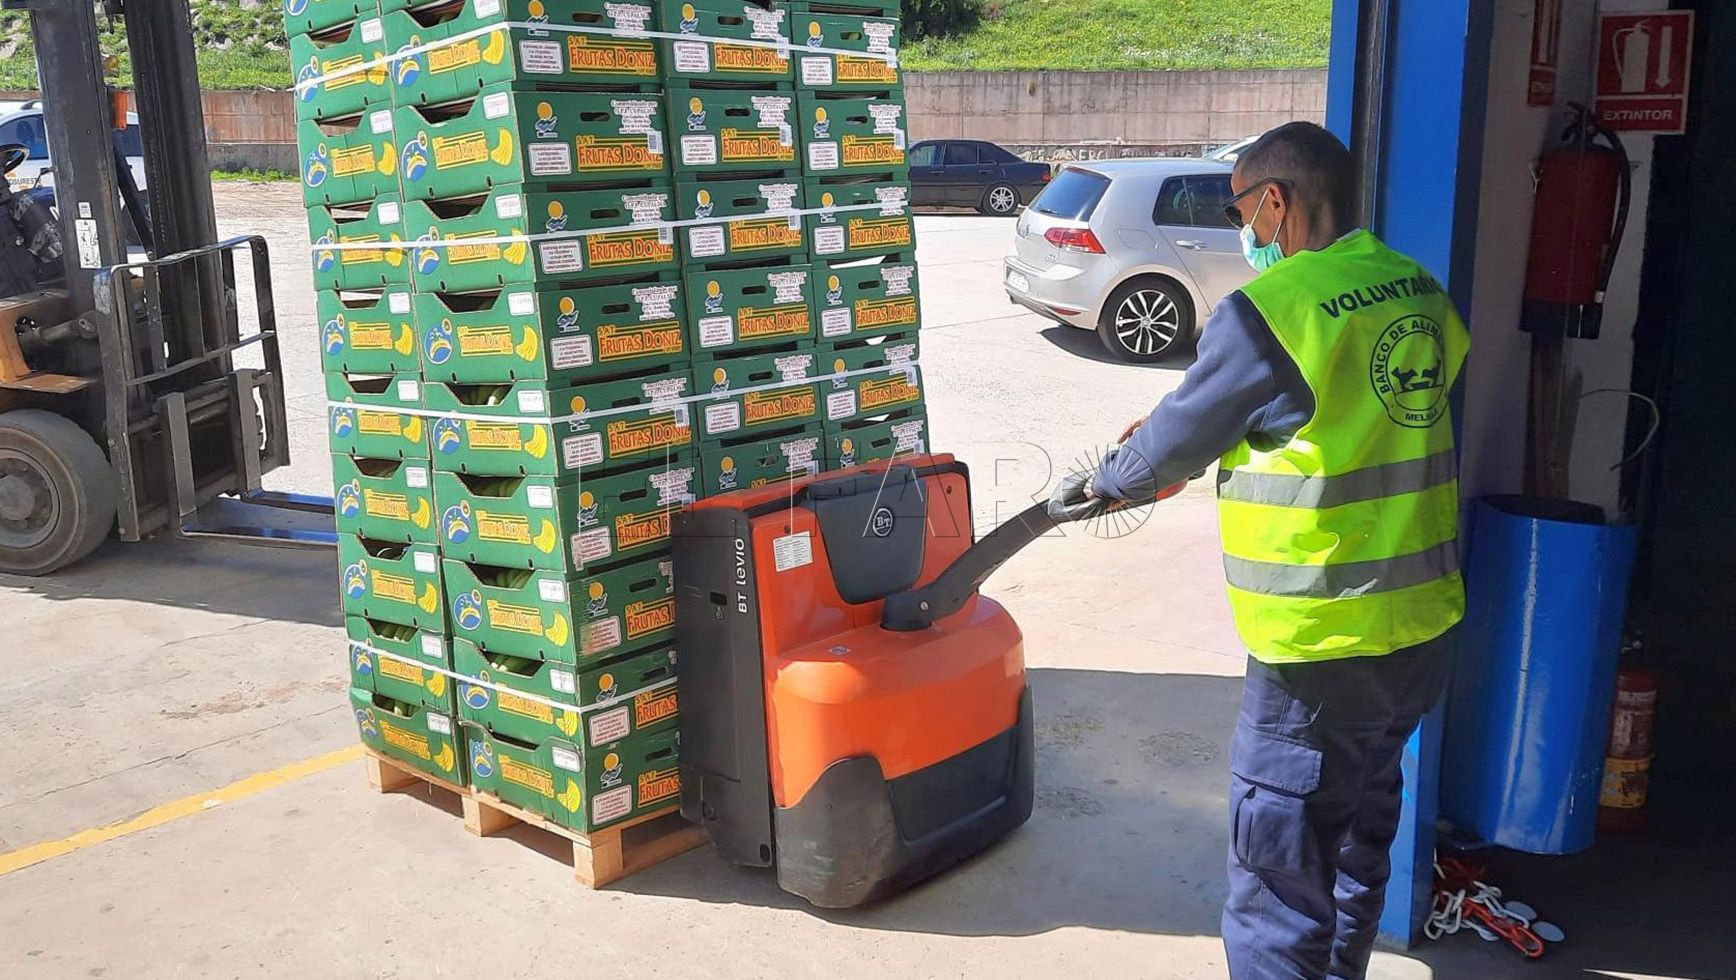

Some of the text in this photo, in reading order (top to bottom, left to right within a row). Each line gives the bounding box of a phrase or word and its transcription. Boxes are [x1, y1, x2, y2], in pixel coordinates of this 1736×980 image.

[571, 47, 614, 67] FRUTAS
[616, 48, 655, 68] DONIZ
[716, 50, 751, 67] FRUTAS
[839, 62, 868, 77] FRUTAS
[1603, 109, 1673, 121] EXTINTOR
[580, 146, 624, 165] FRUTAS
[723, 139, 761, 156] FRUTAS
[845, 145, 876, 161] FRUTAS
[731, 228, 768, 244] FRUTAS
[850, 229, 881, 244] FRUTAS
[881, 225, 909, 241] DONIZ
[590, 242, 634, 261] FRUTAS
[739, 315, 776, 334] FRUTAS
[777, 311, 809, 330] DONIZ
[856, 304, 916, 323] FRUTAS DONIZ
[600, 336, 643, 355] FRUTAS
[644, 331, 681, 349] DONIZ
[1374, 343, 1391, 394] BANCO
[1389, 323, 1408, 341] DE
[861, 387, 890, 404] FRUTAS
[746, 400, 782, 418] FRUTAS
[783, 395, 815, 413] DONIZ
[611, 430, 653, 451] FRUTAS
[877, 516, 891, 527] BT
[618, 521, 660, 545] FRUTAS
[738, 592, 749, 614] BT
[628, 609, 671, 632] FRUTAS
[637, 696, 678, 725] FRUTAS
[639, 777, 680, 804] FRUTAS
